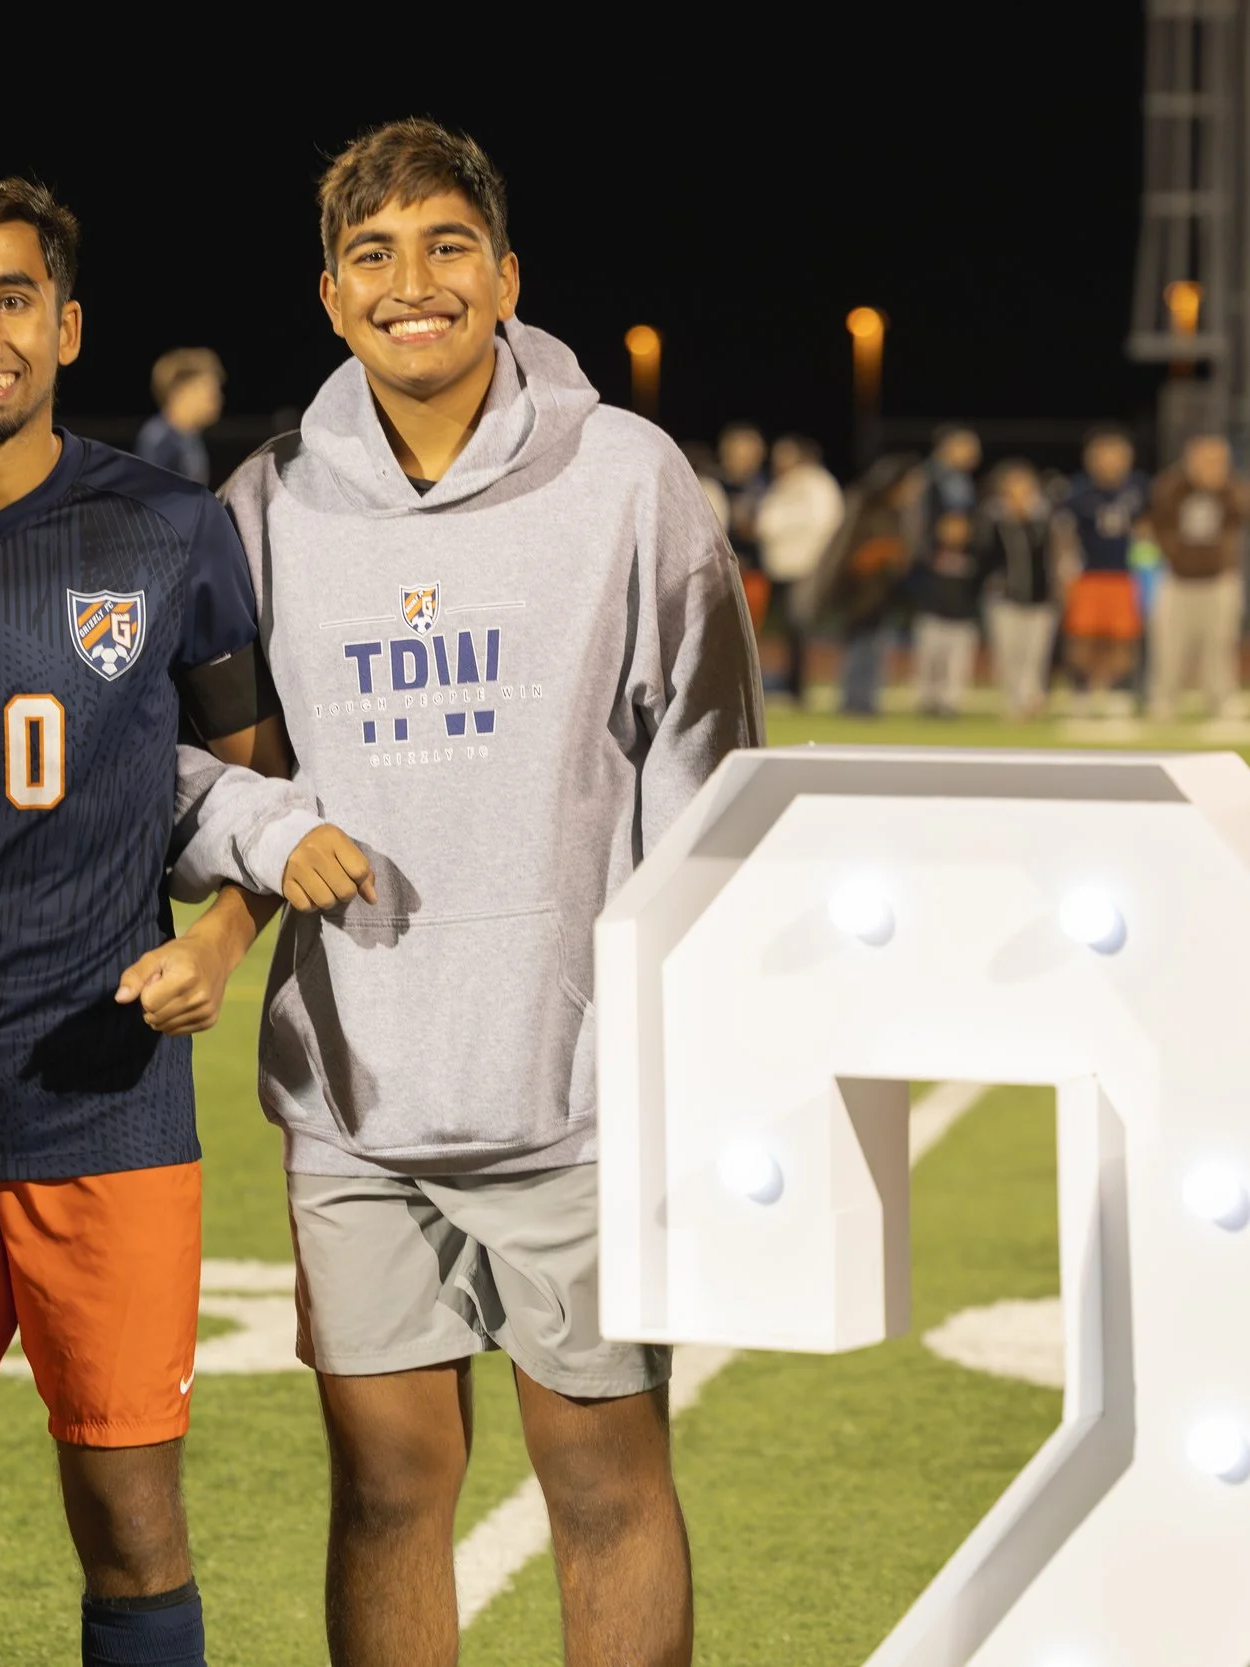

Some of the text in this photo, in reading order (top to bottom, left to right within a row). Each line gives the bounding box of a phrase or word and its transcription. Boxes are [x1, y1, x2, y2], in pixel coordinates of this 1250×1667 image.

[111, 612, 131, 649] G
[313, 684, 543, 718] TOUGH PEOPLE WIN
[369, 745, 489, 767] GRIZZLY FC
